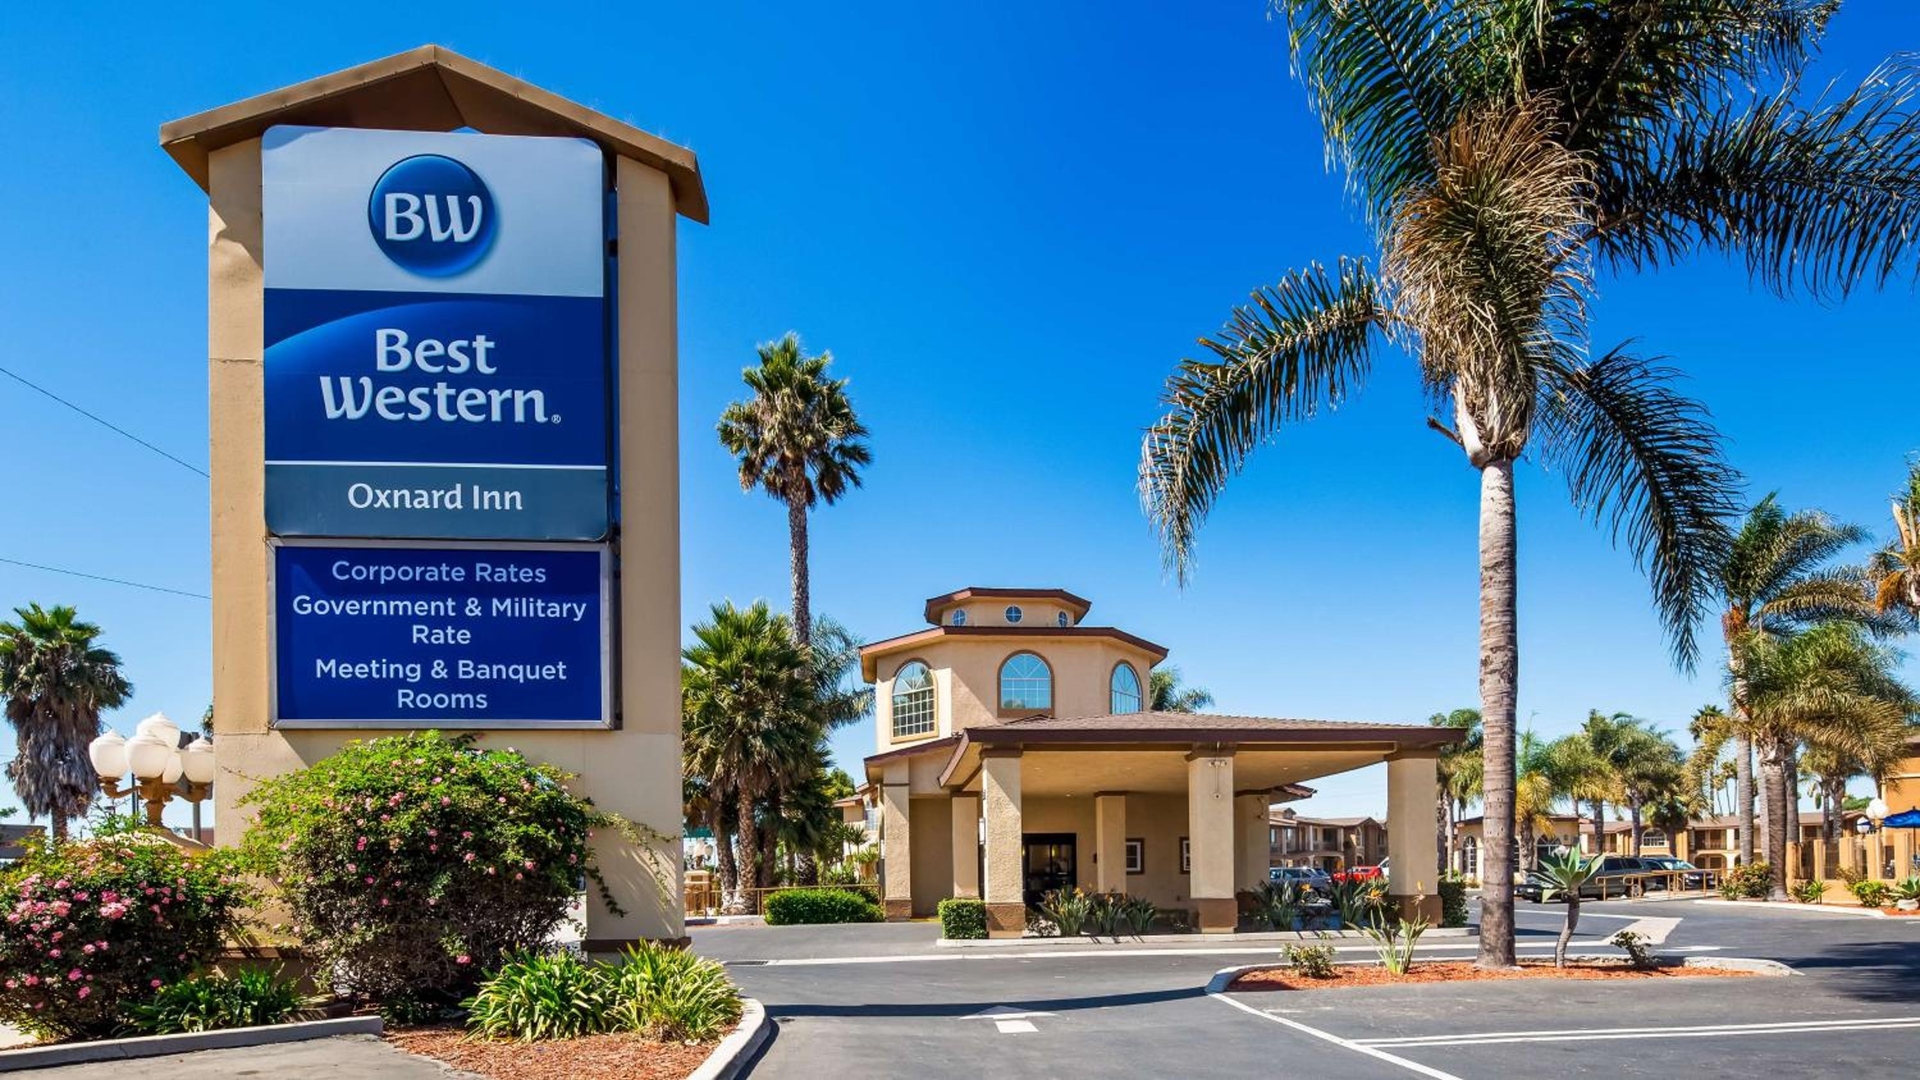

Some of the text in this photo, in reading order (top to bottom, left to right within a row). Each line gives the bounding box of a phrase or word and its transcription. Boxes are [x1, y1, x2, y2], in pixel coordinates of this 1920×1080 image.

[384, 192, 482, 242] BW
[376, 328, 497, 375] Best
[347, 482, 523, 510] Oxnard Inn
[331, 560, 547, 584] Corporate Rates
[292, 595, 587, 621] Government & Military
[412, 625, 472, 645] Rate
[315, 659, 567, 683] Meeting & Banquet
[397, 689, 488, 709] Rooms
